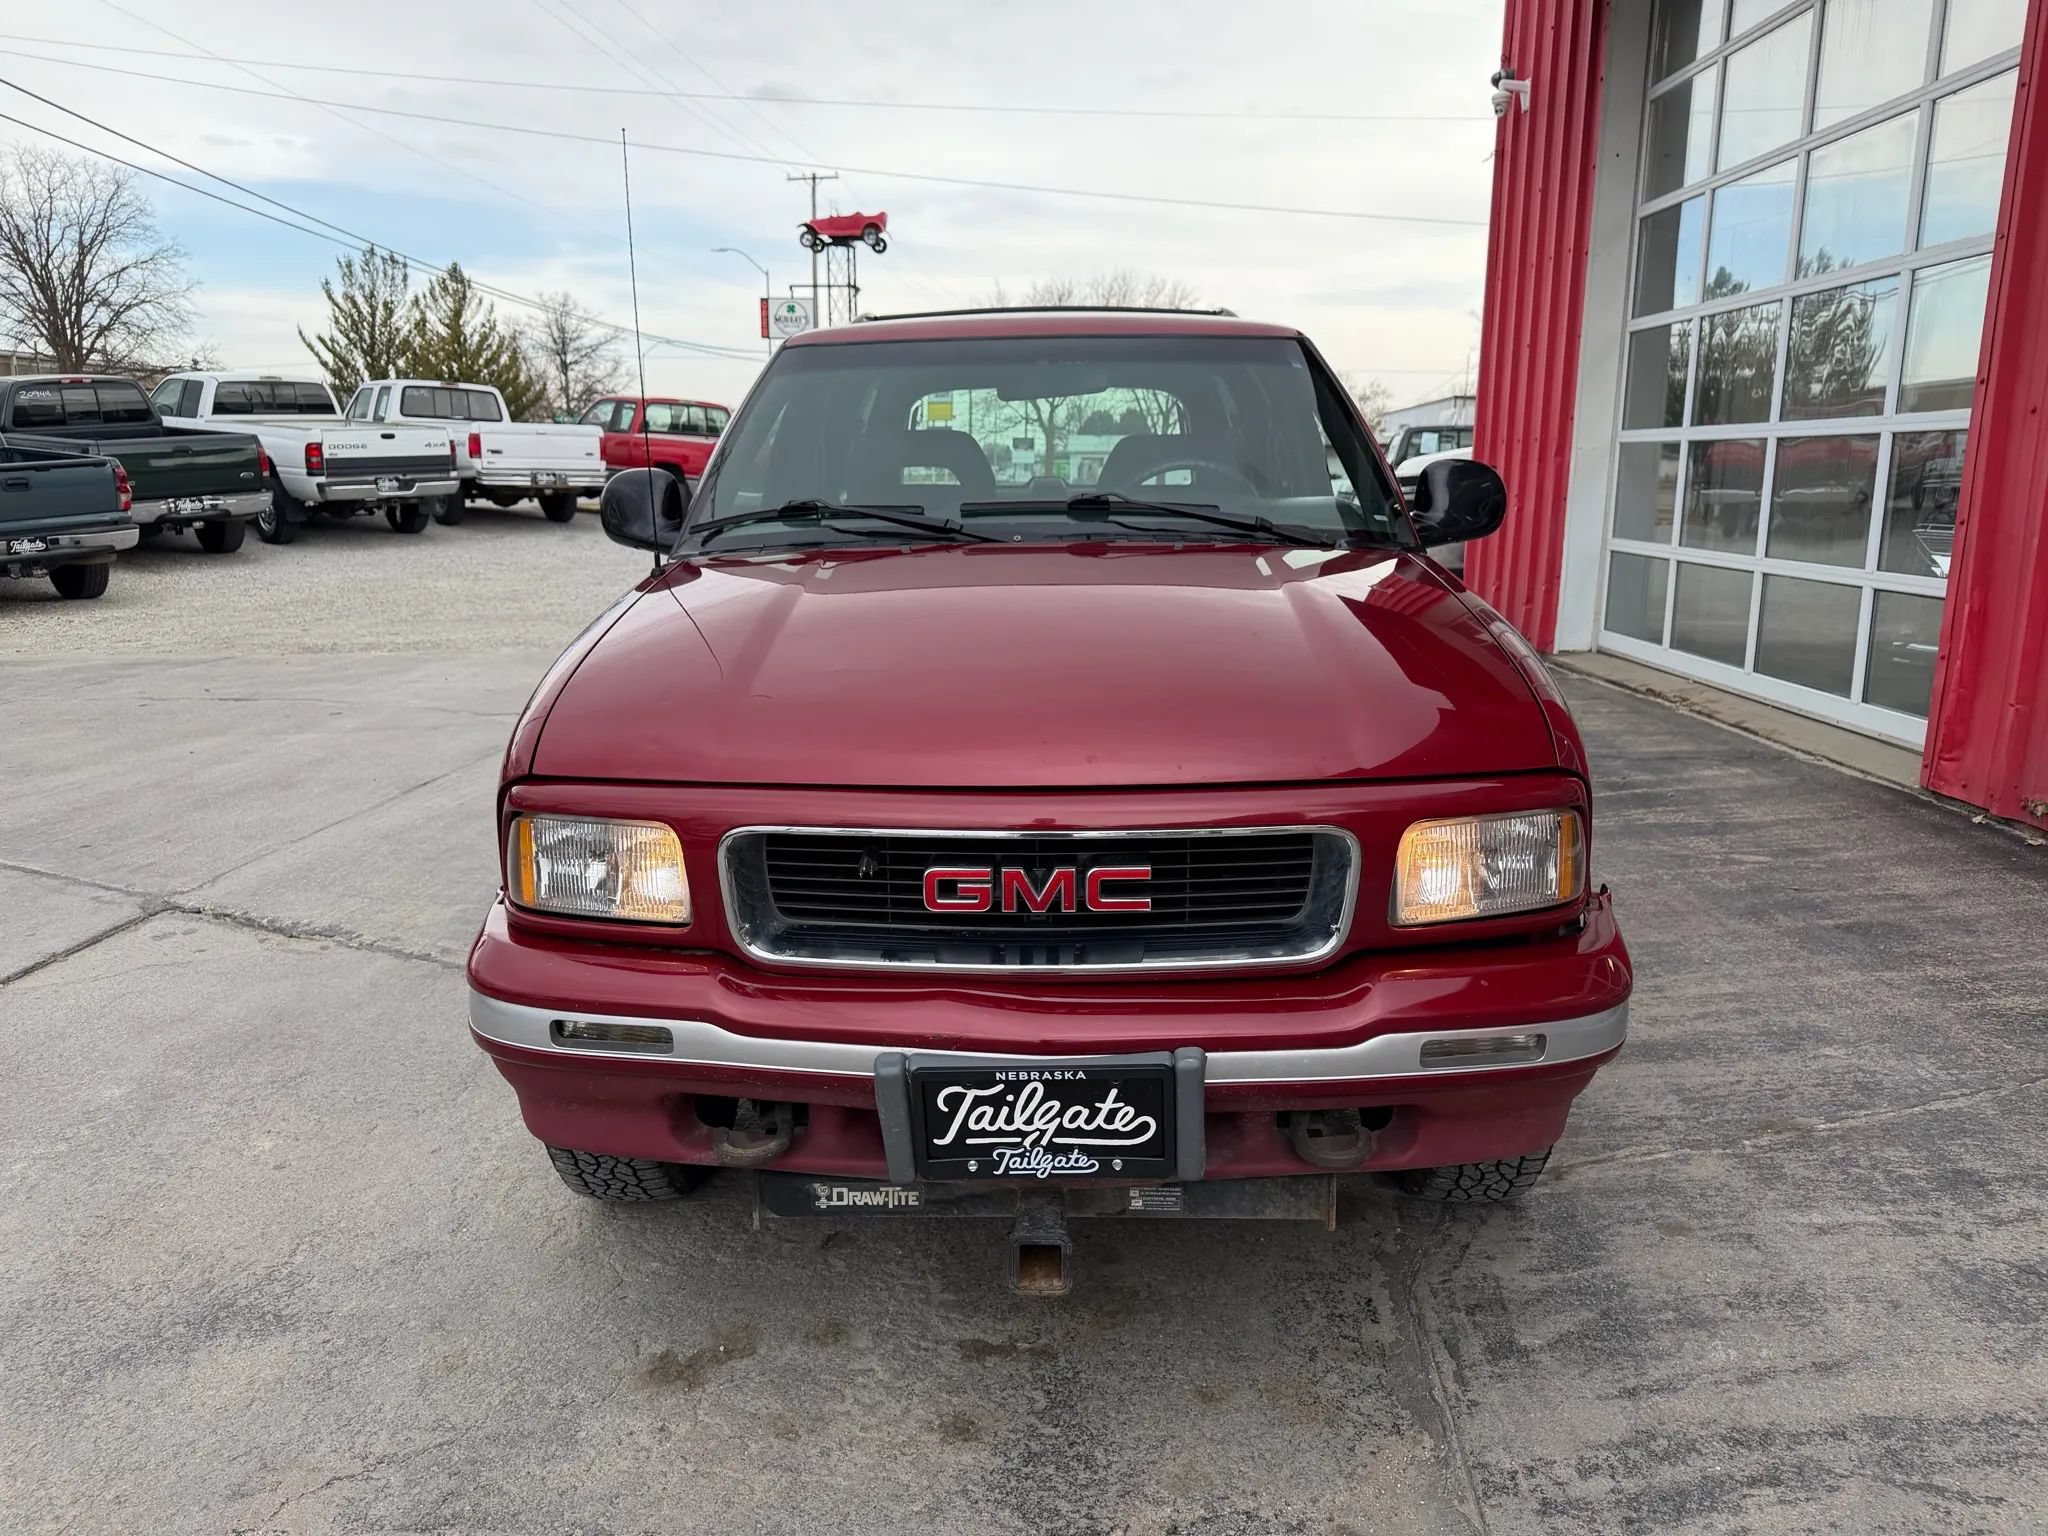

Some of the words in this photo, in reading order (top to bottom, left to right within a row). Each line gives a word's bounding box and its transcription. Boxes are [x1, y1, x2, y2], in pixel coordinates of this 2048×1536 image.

[10, 539, 46, 553] Tailgate
[923, 866, 1151, 912] GMC
[996, 1071, 1087, 1081] NEBRASKA
[933, 1081, 1156, 1149] Tailgate
[992, 1147, 1100, 1179] Tailgate
